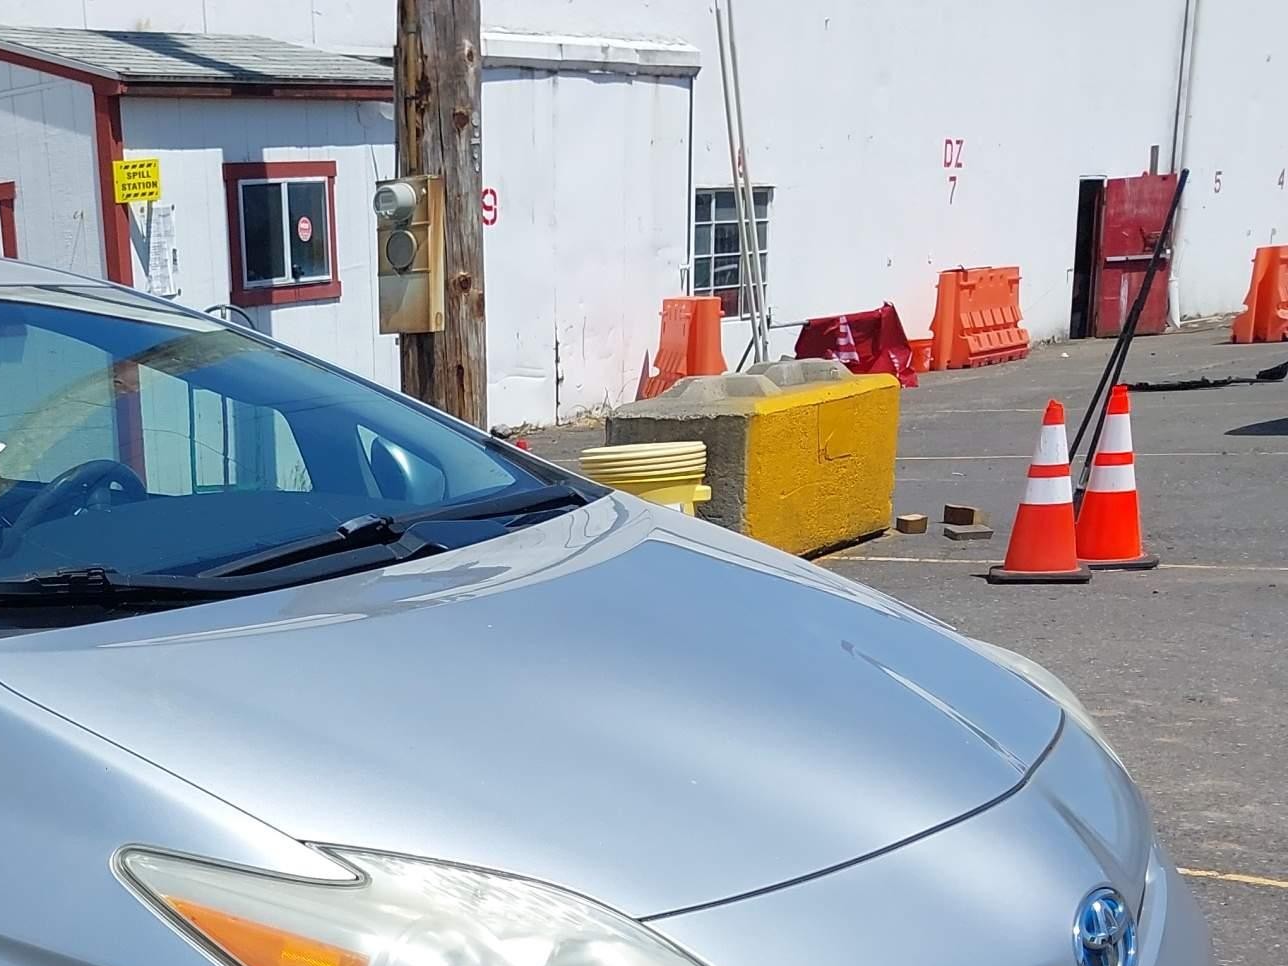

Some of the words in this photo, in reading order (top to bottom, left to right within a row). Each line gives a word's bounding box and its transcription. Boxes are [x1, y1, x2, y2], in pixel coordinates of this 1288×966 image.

[943, 139, 964, 168] DZ
[121, 181, 158, 192] STATION
[126, 170, 152, 180] SPILL
[1214, 170, 1223, 193] 5
[1277, 168, 1286, 190] 4
[948, 176, 957, 205] 7
[481, 188, 497, 226] 9
